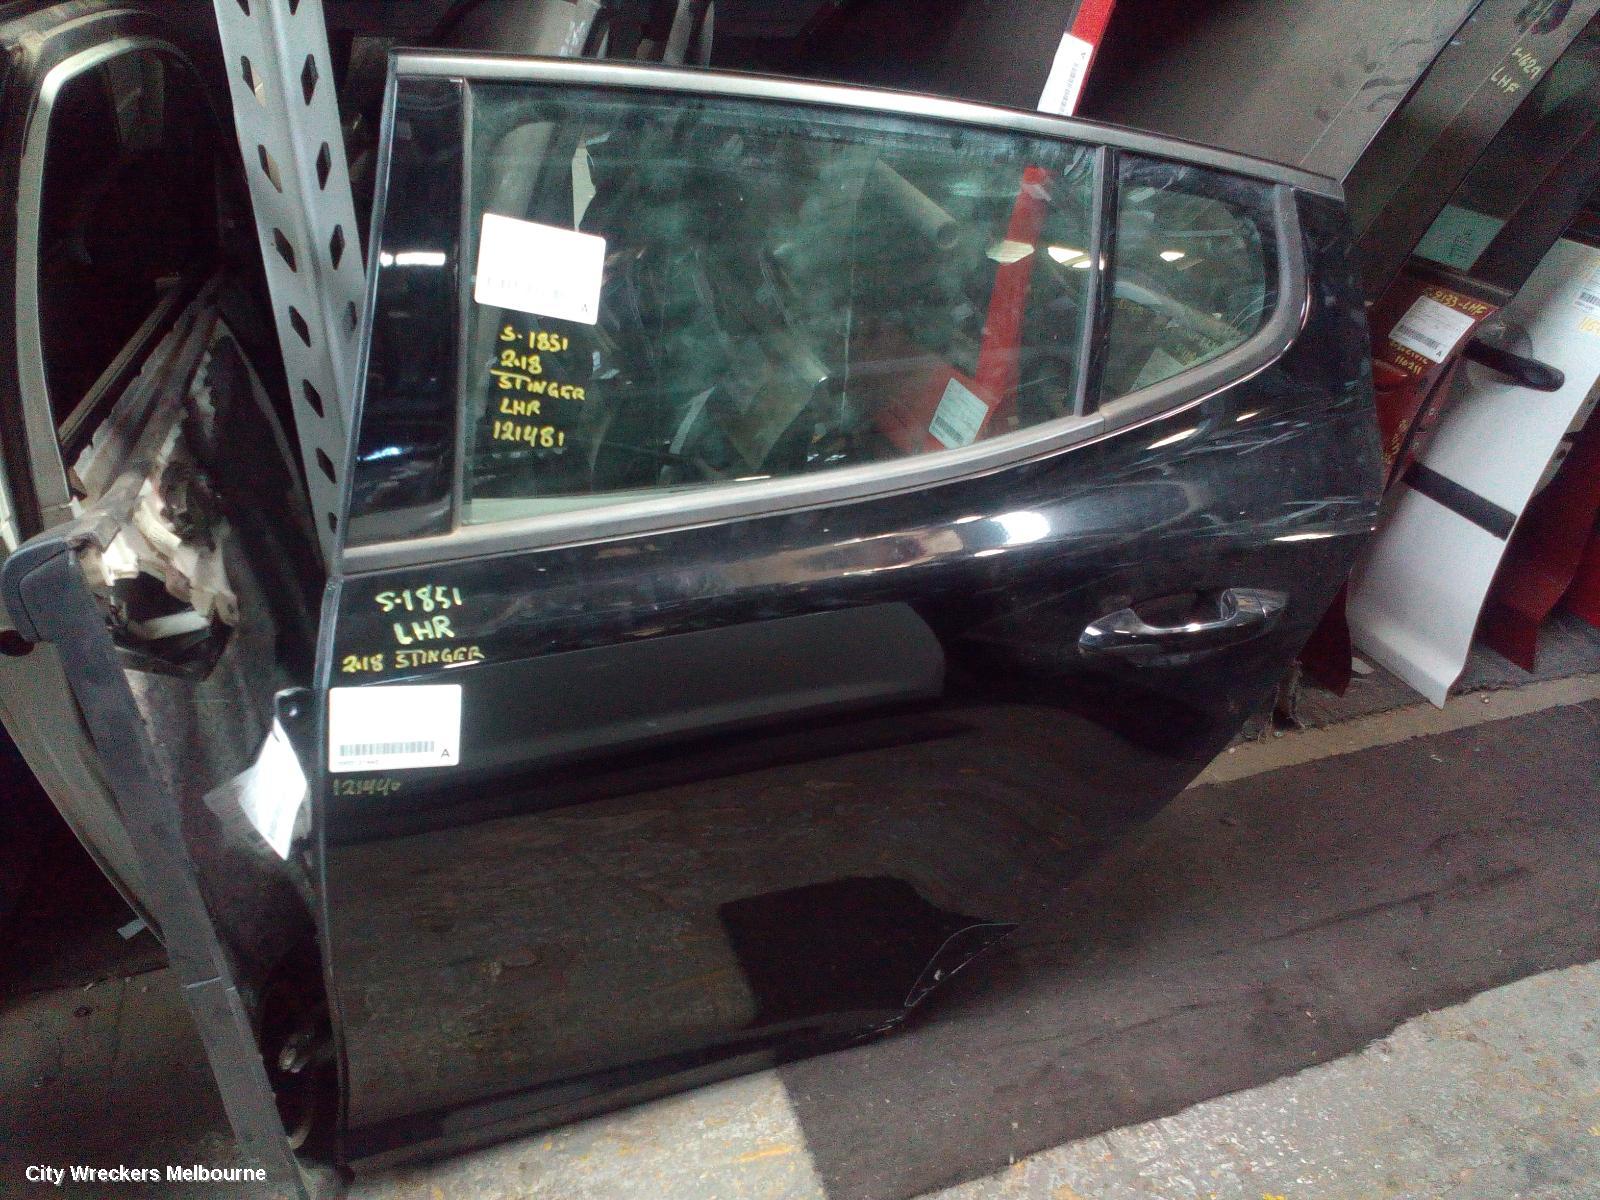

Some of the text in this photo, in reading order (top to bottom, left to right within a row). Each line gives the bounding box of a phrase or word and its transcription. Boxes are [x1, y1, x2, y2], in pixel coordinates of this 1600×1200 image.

[490, 368, 585, 401] STINGER
[500, 397, 541, 416] LHR
[493, 420, 565, 448] 121481
[393, 615, 455, 645] LHR
[395, 646, 485, 668] STINGER
[440, 748, 450, 758] A
